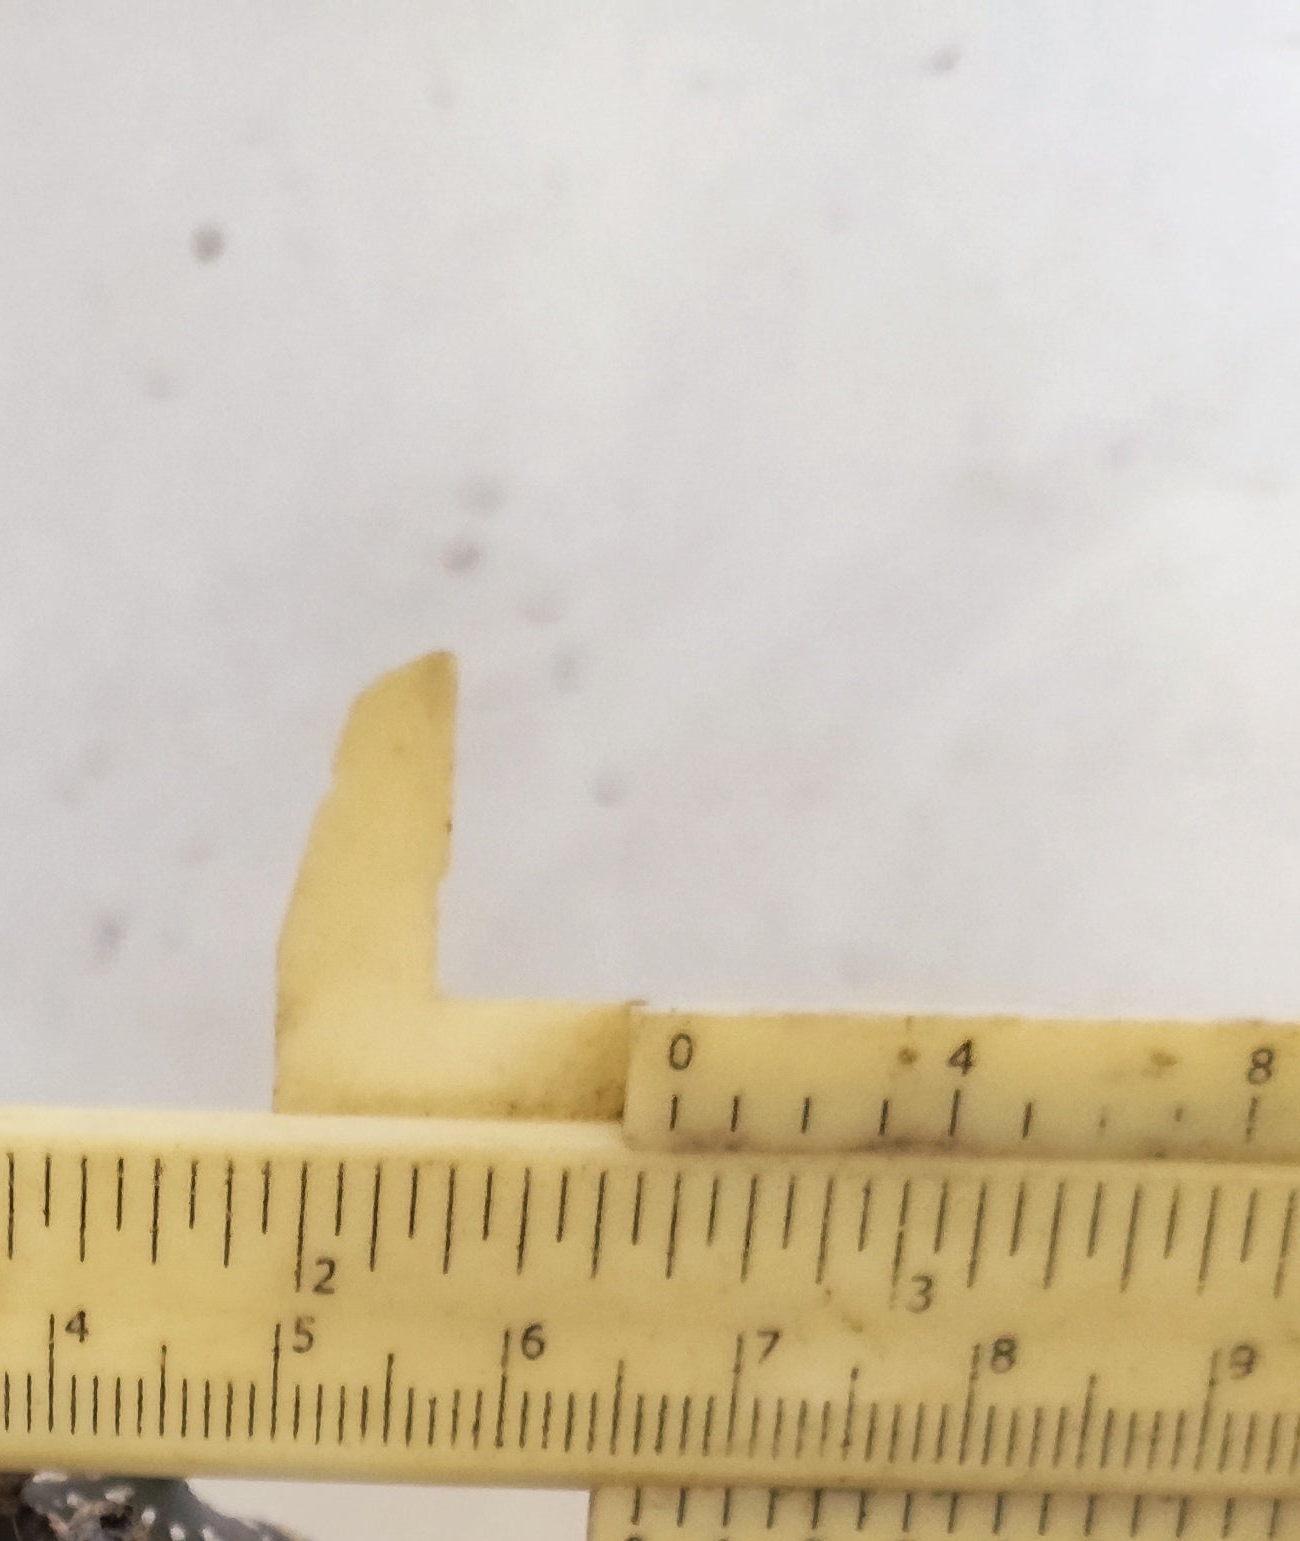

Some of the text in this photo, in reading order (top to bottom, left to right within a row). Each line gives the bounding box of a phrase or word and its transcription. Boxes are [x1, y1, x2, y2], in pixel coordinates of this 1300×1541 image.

[669, 1033, 1276, 1085] 0 4 8
[313, 1258, 336, 1295] 2
[908, 1274, 934, 1313] 3
[66, 1309, 89, 1343] 4
[291, 1318, 316, 1353] 5
[521, 1324, 545, 1360] 6
[756, 1330, 780, 1364] 7
[991, 1337, 1017, 1373] 8
[1229, 1344, 1257, 1379] 9
